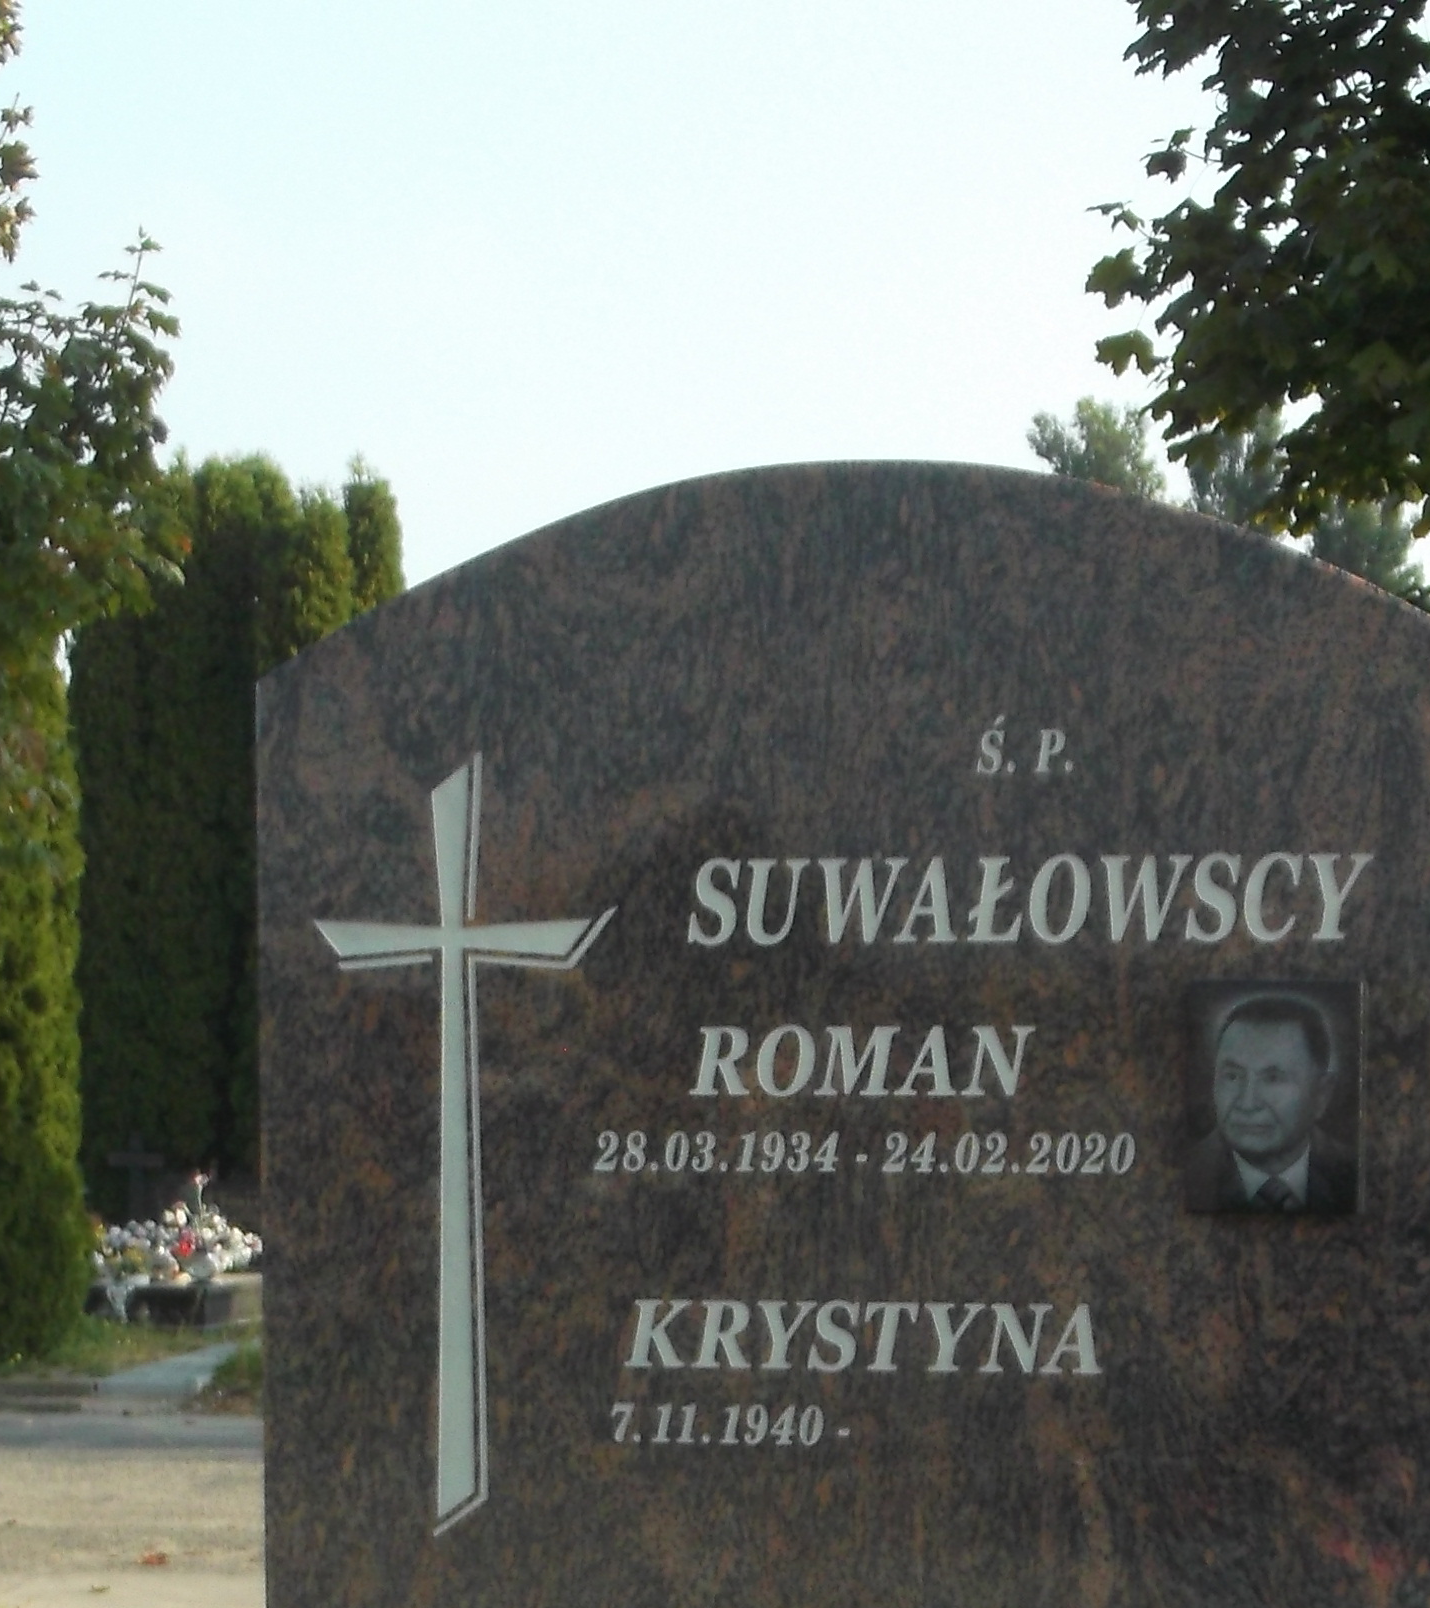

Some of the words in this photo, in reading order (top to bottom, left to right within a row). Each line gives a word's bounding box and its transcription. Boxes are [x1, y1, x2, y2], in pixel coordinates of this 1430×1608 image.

[687, 851, 1373, 947] SUWAŁOWSCY
[689, 1023, 1036, 1098] ROMAN
[592, 1129, 839, 1174] 28.03.1934
[880, 1130, 1137, 1175] 24.02.2020
[624, 1297, 1104, 1375] KRYSTYNA
[608, 1401, 825, 1446] 7.11.1940
